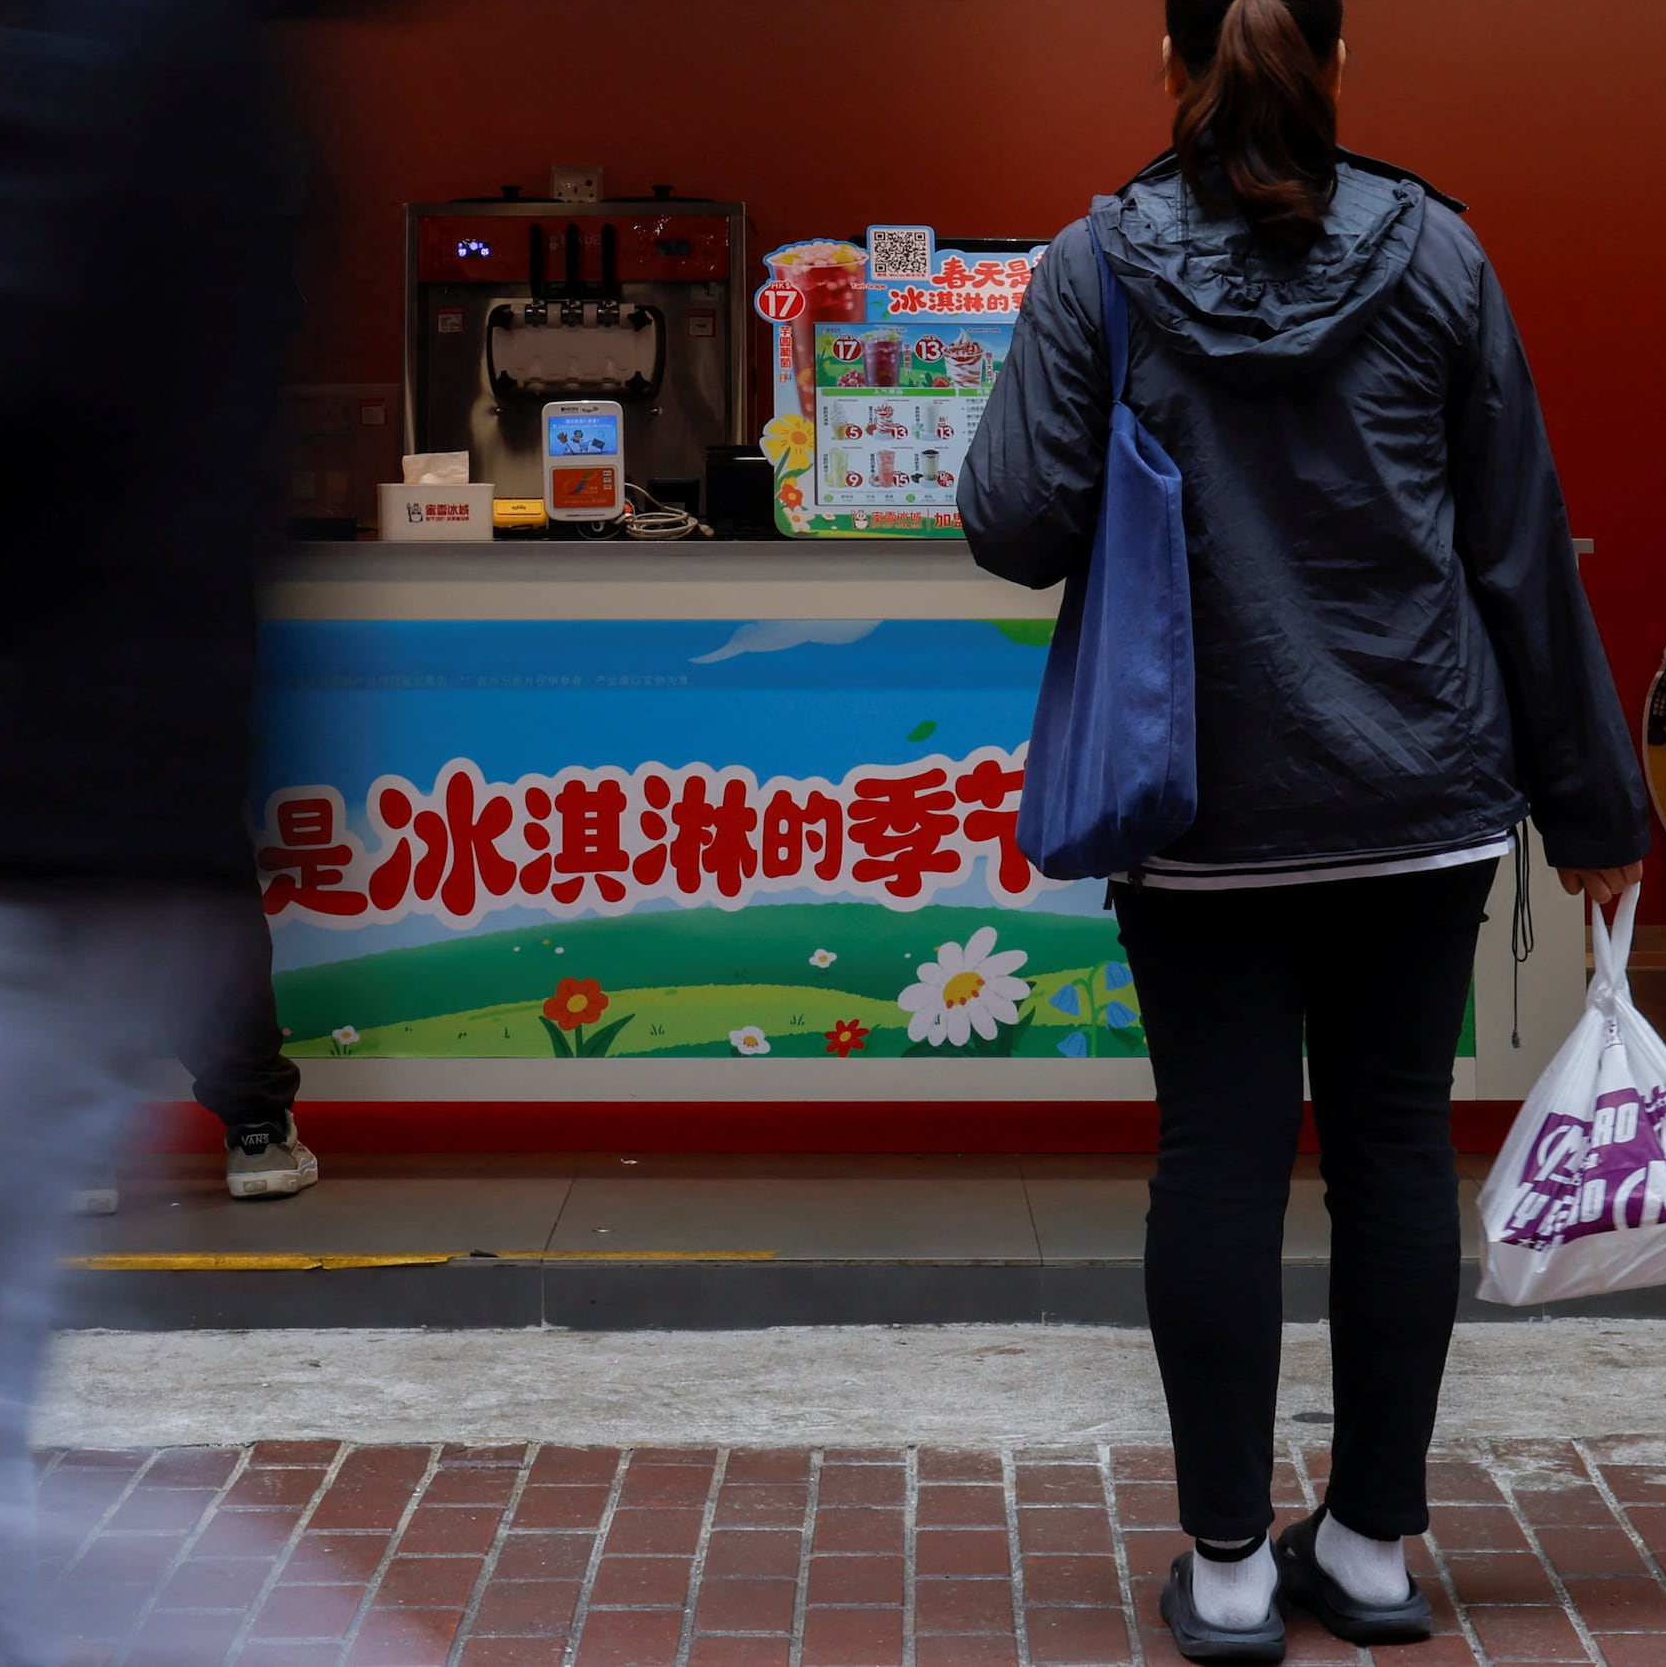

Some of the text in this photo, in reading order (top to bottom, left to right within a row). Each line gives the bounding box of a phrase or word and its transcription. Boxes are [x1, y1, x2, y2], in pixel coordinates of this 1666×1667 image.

[932, 255, 1033, 289] 春天是
[764, 291, 797, 318] 17
[836, 341, 859, 360] 17
[919, 341, 942, 360] 13
[848, 427, 859, 439] 5
[892, 426, 906, 439] 13
[938, 426, 953, 439] 13
[849, 475, 859, 487] 9
[425, 504, 470, 516] 蜜雪冰城
[871, 511, 922, 523] 蜜雪冰城
[241, 1132, 270, 1147] VANS
